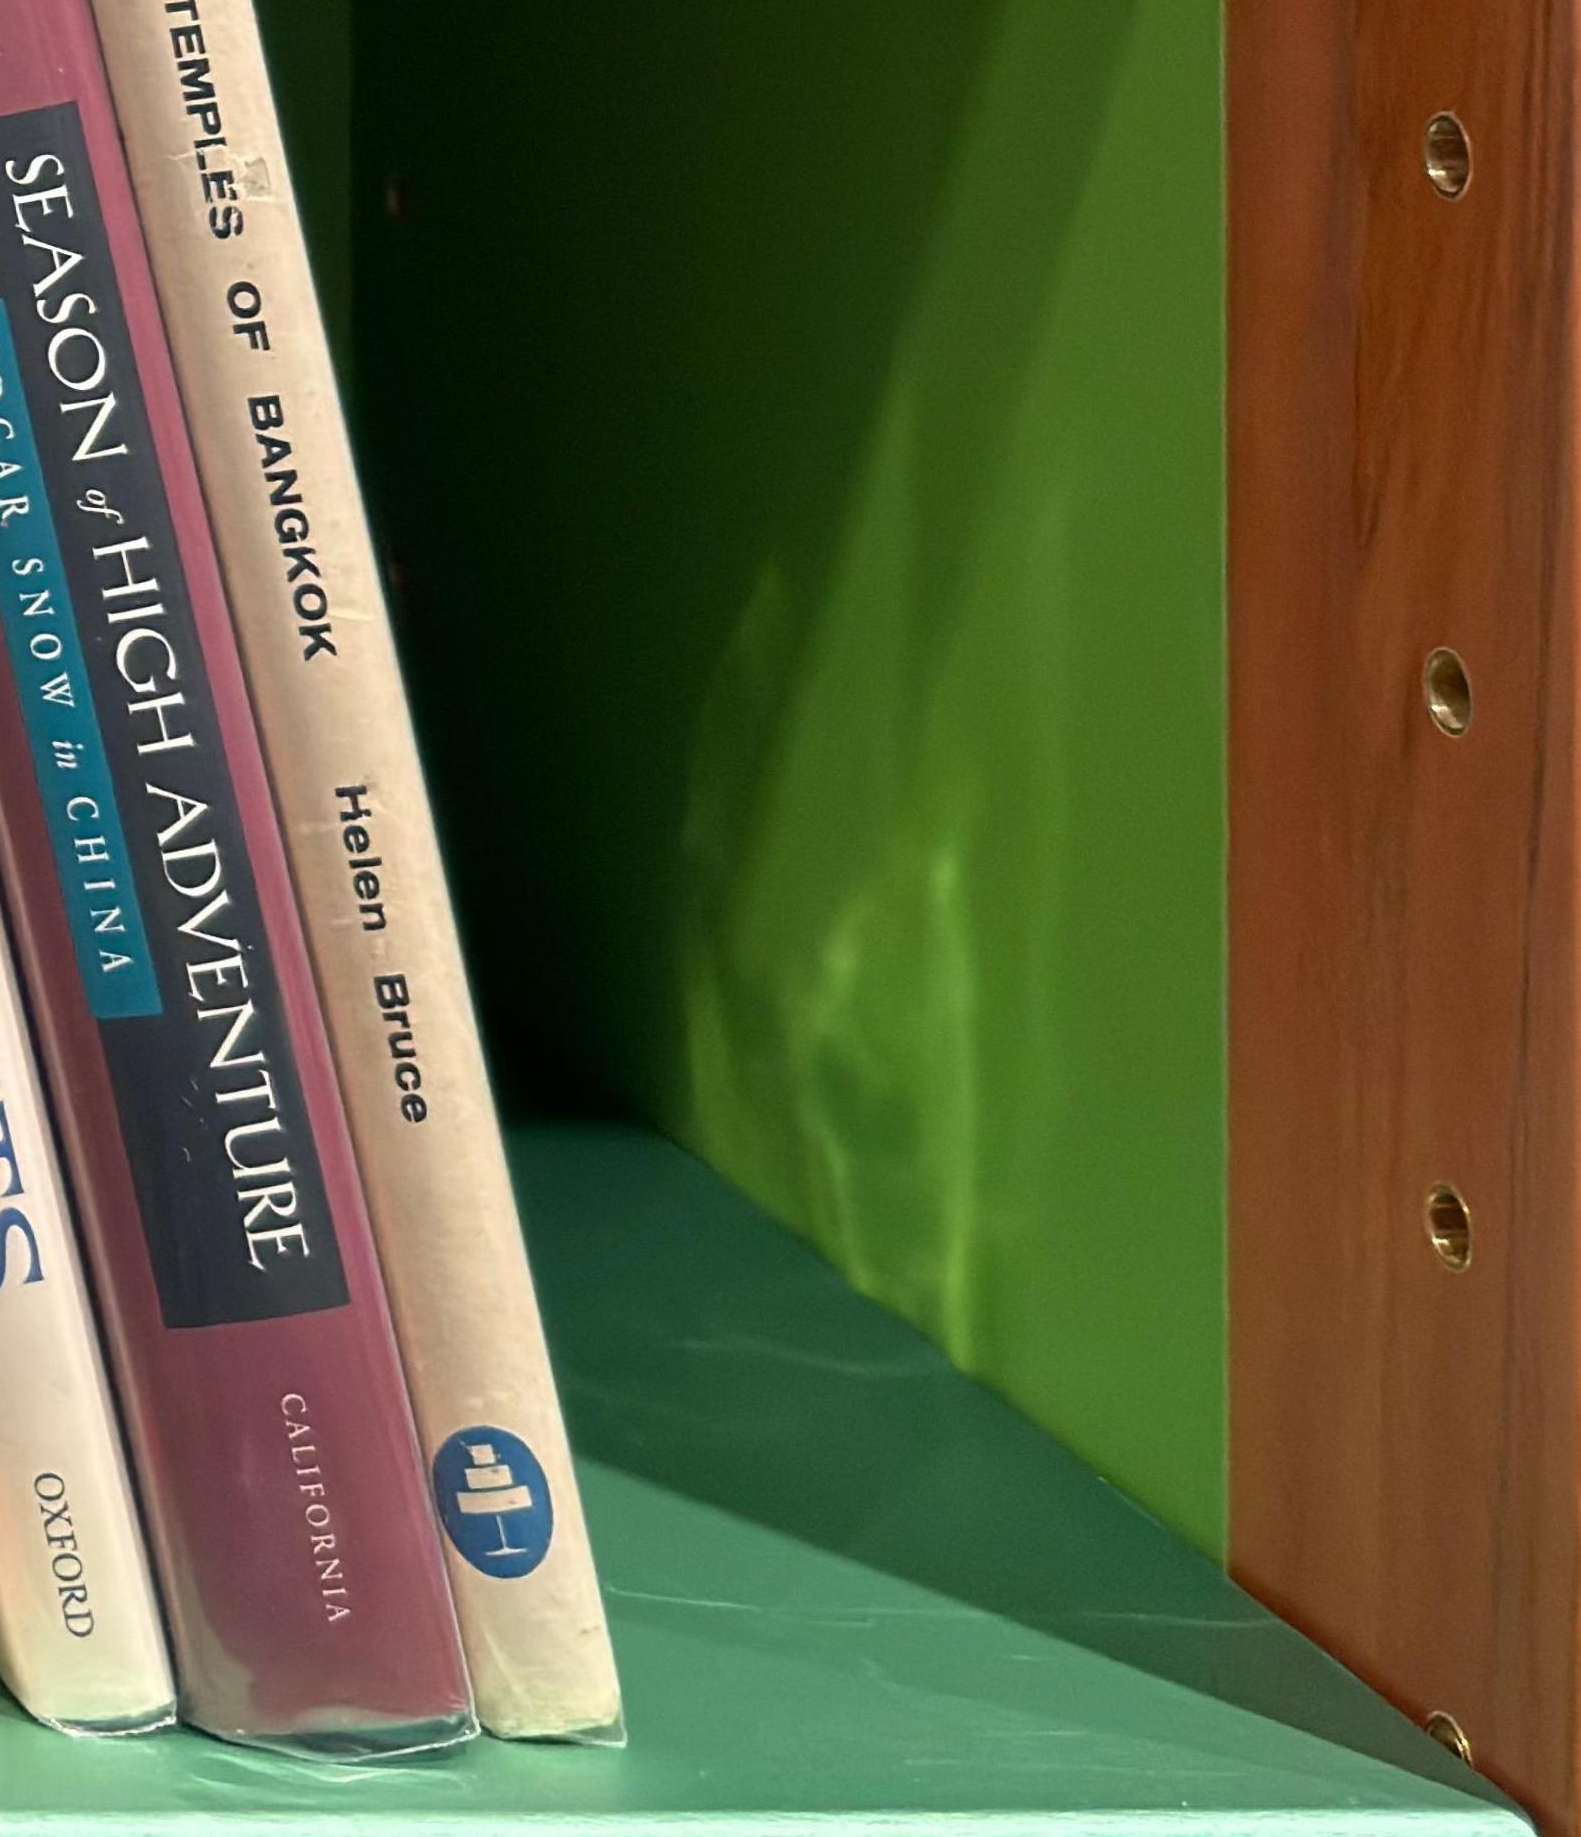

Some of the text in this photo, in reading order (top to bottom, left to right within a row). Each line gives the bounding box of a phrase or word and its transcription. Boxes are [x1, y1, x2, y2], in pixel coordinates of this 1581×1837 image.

[226, 280, 271, 352] OF
[247, 394, 337, 663] BANGKOK
[5, 153, 312, 1272] SEASON of HIGH ADVENTURE
[11, 557, 76, 708] SNOW
[51, 741, 81, 769] in
[66, 795, 134, 975] CHINA
[34, 1472, 95, 1638] OXFORD
[279, 1391, 352, 1622] CALIFORNIA
